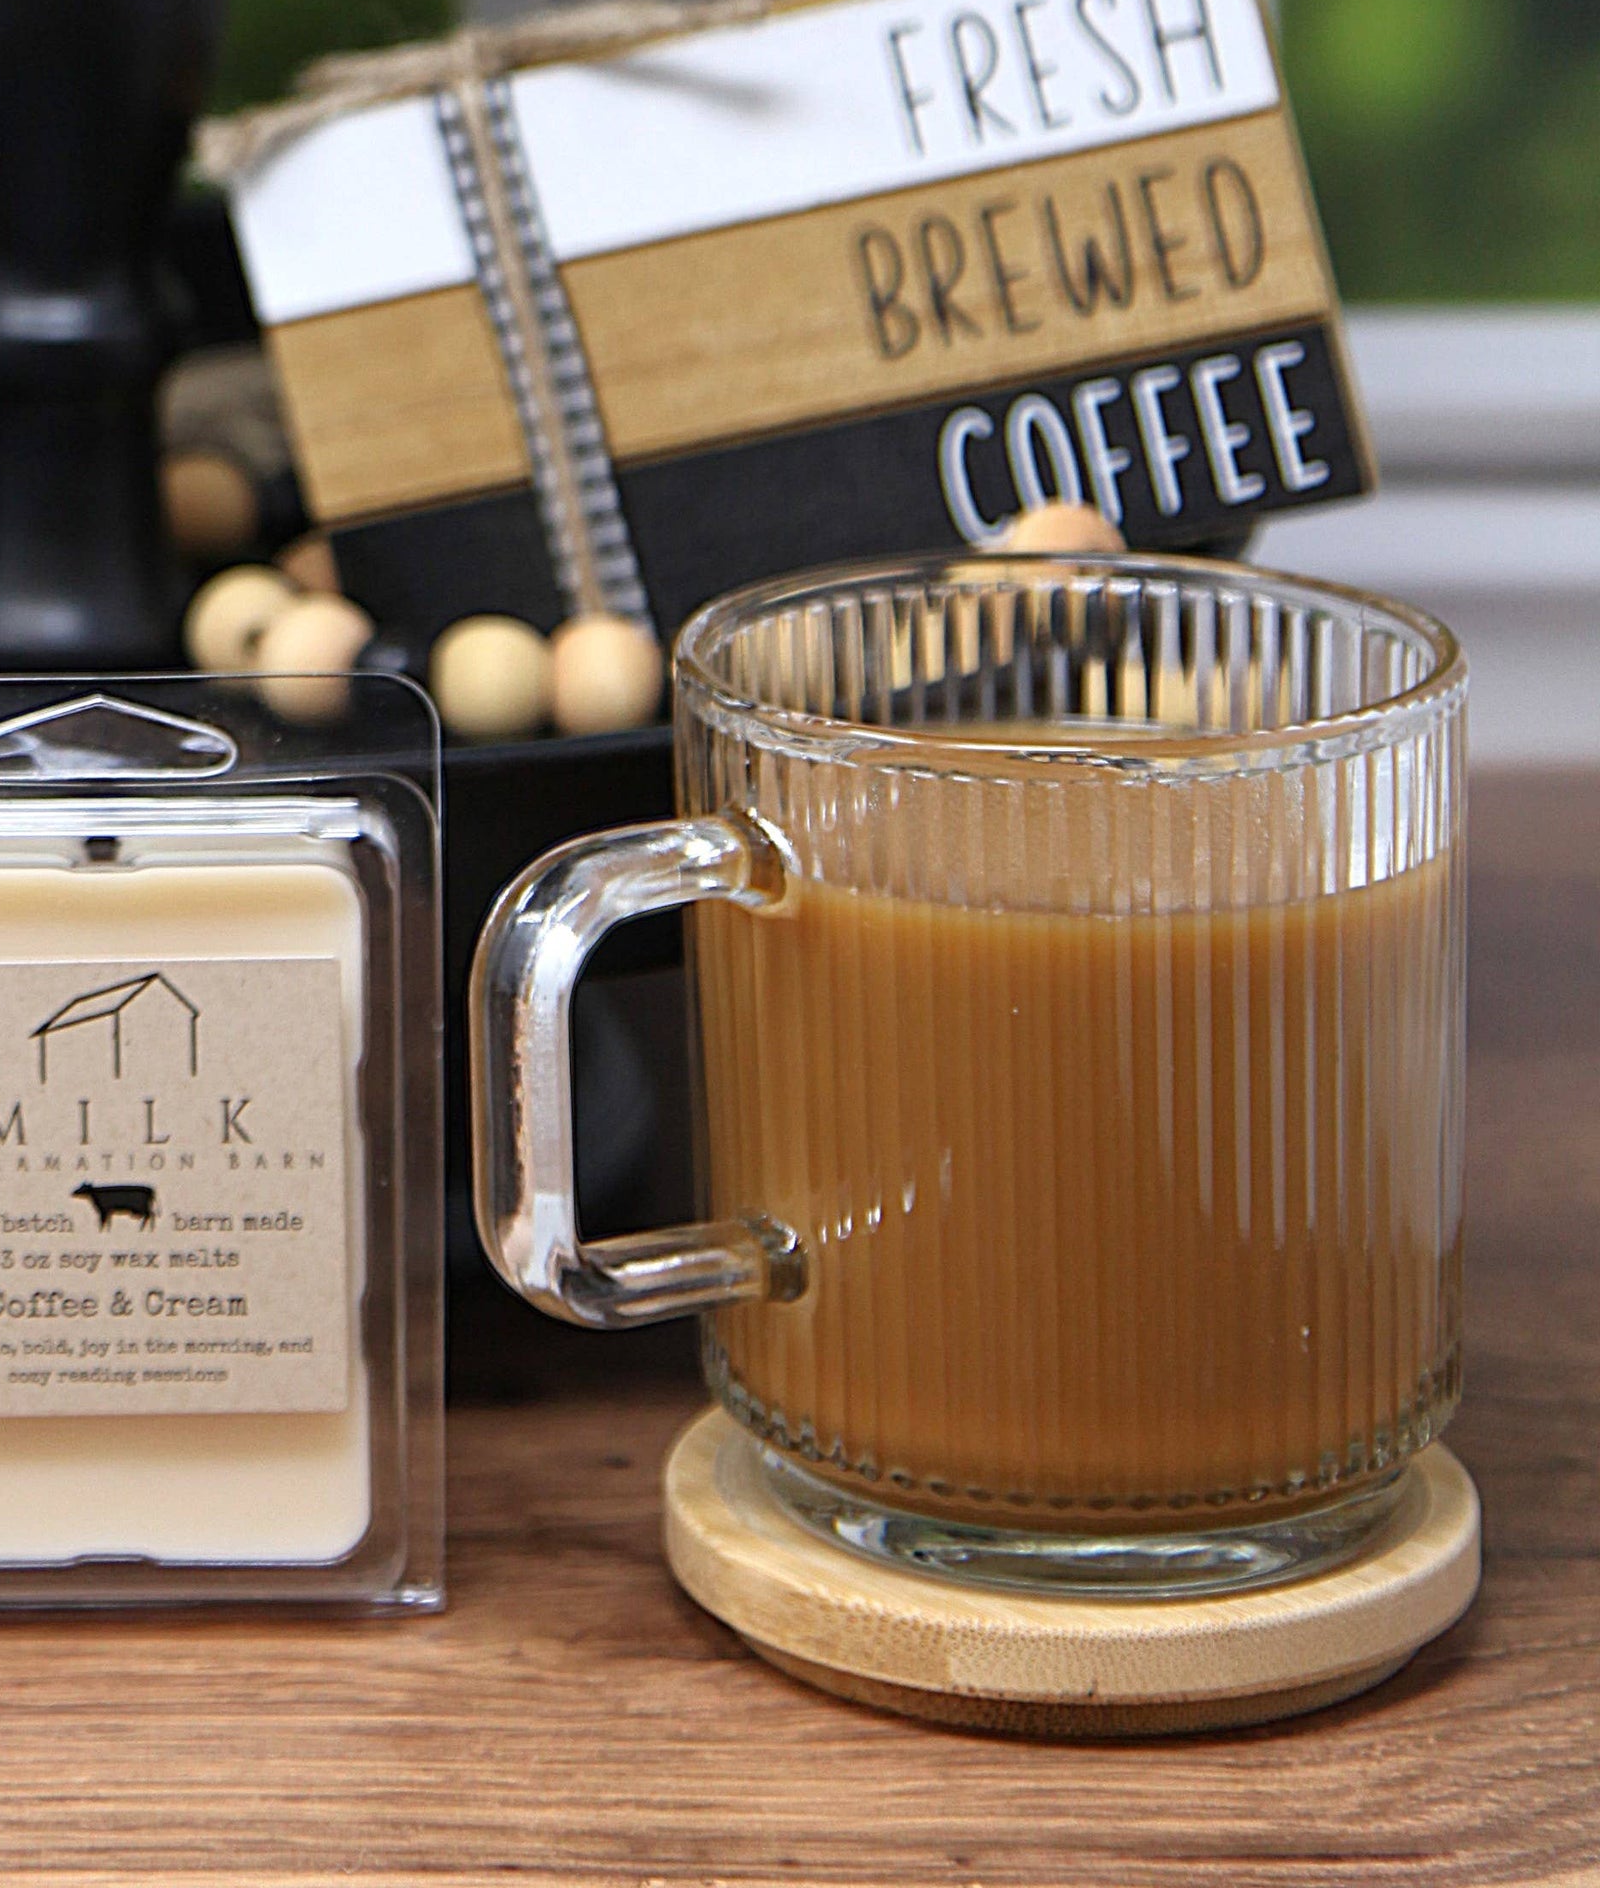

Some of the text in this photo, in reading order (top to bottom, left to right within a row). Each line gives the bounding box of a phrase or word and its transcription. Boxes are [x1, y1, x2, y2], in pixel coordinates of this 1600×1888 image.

[856, 154, 1265, 361] BREWED
[938, 340, 1330, 549] COFFEE
[229, 1152, 326, 1171] BARN
[1, 1212, 74, 1233] batch
[172, 1211, 233, 1231] barn
[243, 1211, 304, 1231] made
[0, 1248, 240, 1274] 3 oz soy wax melts
[109, 1290, 133, 1316] &
[144, 1289, 249, 1317] Cream
[22, 1338, 75, 1357] bold,
[79, 1339, 110, 1358] joy
[116, 1338, 139, 1354] in
[145, 1338, 178, 1354] the
[184, 1338, 274, 1357] morning,
[278, 1337, 313, 1354] and
[7, 1367, 229, 1387] cozy reading sessions
